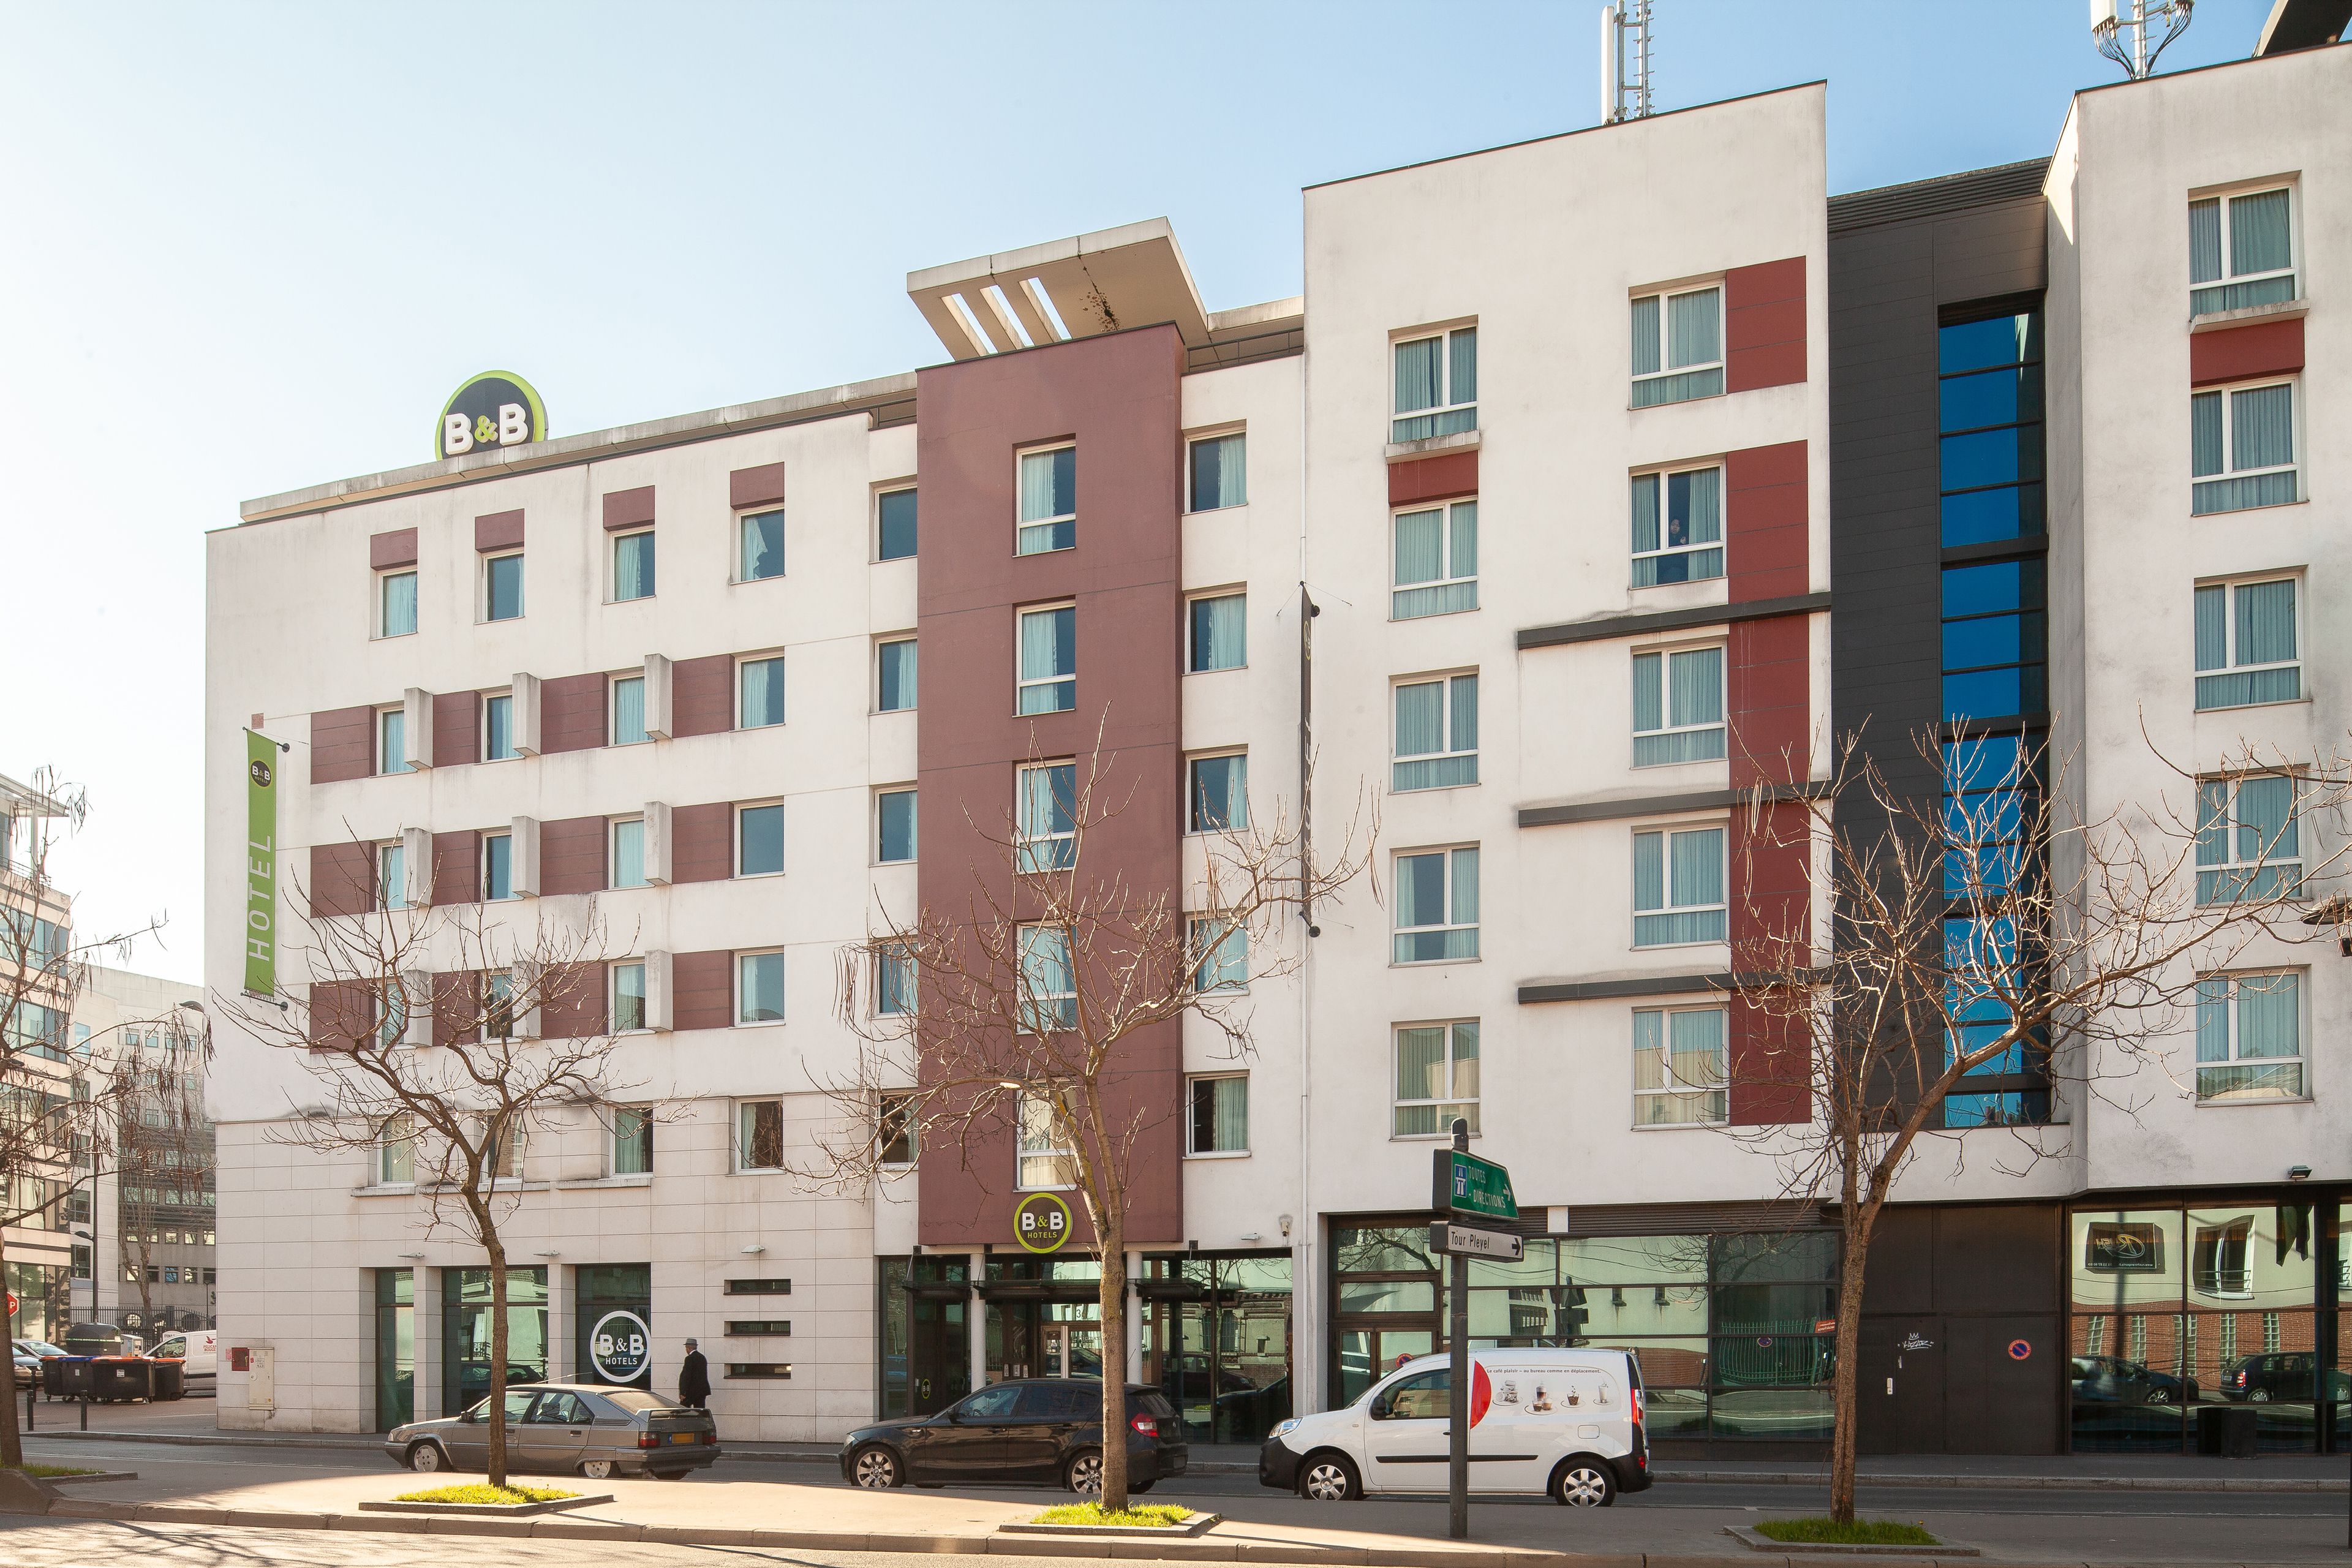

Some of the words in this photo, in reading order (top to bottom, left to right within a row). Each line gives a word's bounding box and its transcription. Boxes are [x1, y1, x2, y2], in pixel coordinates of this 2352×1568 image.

[445, 403, 529, 456] B&B
[252, 765, 270, 781] B&B
[248, 835, 270, 962] HOTEL
[1468, 1166, 1486, 1184] TOUTES
[1473, 1189, 1506, 1208] DIRECTIONS
[1022, 1212, 1064, 1231] B&B
[1451, 1231, 1466, 1246] Tour
[1469, 1234, 1490, 1251] Pleyel
[600, 1334, 644, 1355] B&B
